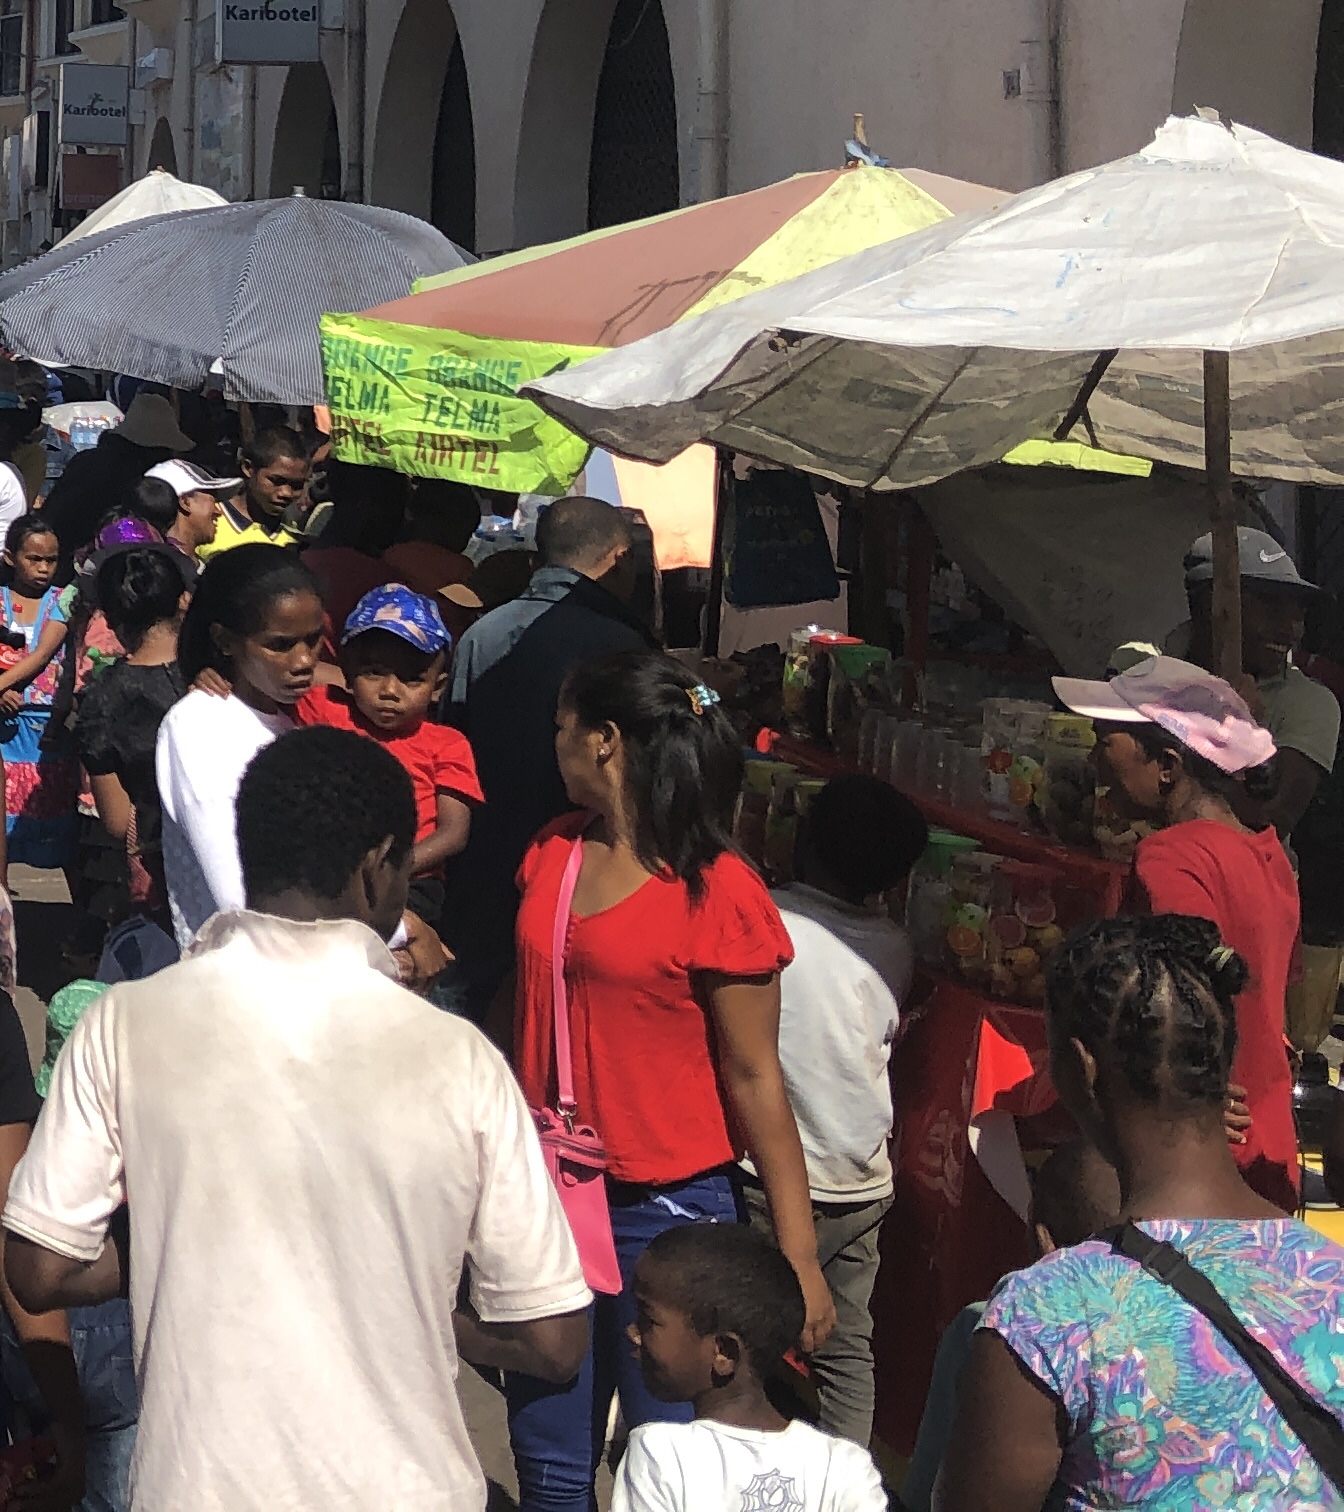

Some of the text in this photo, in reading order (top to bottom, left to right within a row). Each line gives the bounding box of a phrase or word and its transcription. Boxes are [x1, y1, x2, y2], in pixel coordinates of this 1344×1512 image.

[225, 4, 317, 22] Karibotel
[63, 103, 126, 118] Karibotel
[425, 392, 500, 434] TELMA
[414, 431, 500, 475] AIRTEL
